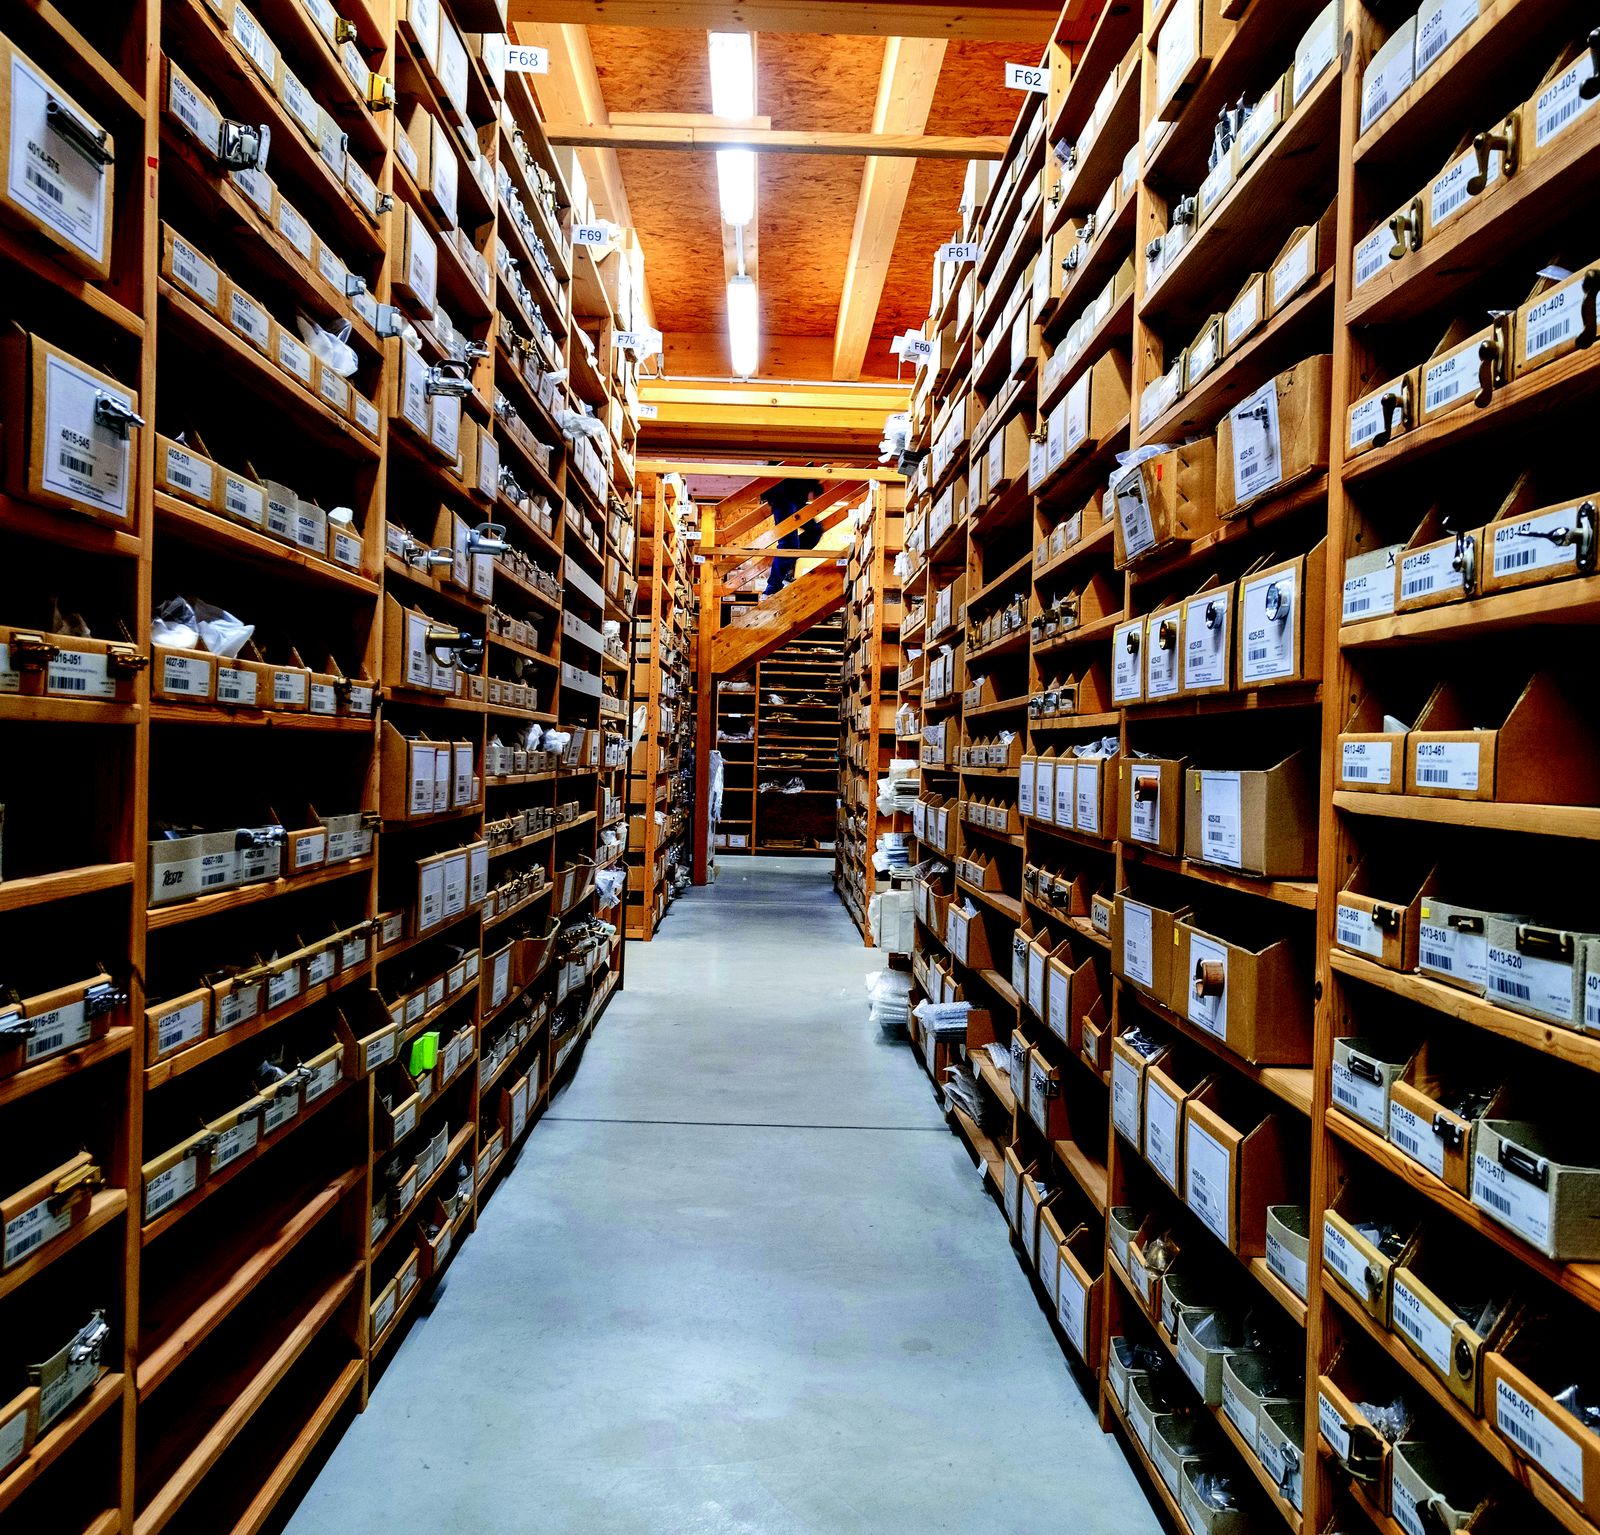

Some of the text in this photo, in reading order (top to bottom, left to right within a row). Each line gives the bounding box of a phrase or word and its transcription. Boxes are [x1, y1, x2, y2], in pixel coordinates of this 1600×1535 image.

[509, 51, 538, 66] F68
[1014, 69, 1041, 87] F62
[1538, 70, 1576, 109] 4013-405
[27, 140, 60, 174] 4014-575
[1433, 165, 1461, 195] 4013-404
[579, 230, 601, 242] F69
[948, 246, 969, 258] F61
[1528, 293, 1564, 323] 4013-409
[617, 335, 635, 344] F70
[914, 341, 930, 353] F60
[1427, 359, 1455, 381] 4013-408
[1352, 401, 1373, 420] 4013-407
[60, 427, 90, 450] 4015-545
[1403, 553, 1430, 569] 4013-456
[1345, 577, 1366, 590] 4013-412
[51, 653, 81, 665] 016-051
[1345, 745, 1365, 754] 4013-460
[1418, 745, 1444, 755] 4013-461
[1420, 926, 1446, 942] 4013-610
[1489, 949, 1522, 969] 4013-620
[1476, 1155, 1505, 1183] 4013-670
[7, 1209, 38, 1234] 4016-700
[1395, 1284, 1419, 1313] 4446-012
[1498, 1383, 1534, 1423] 4446-021
